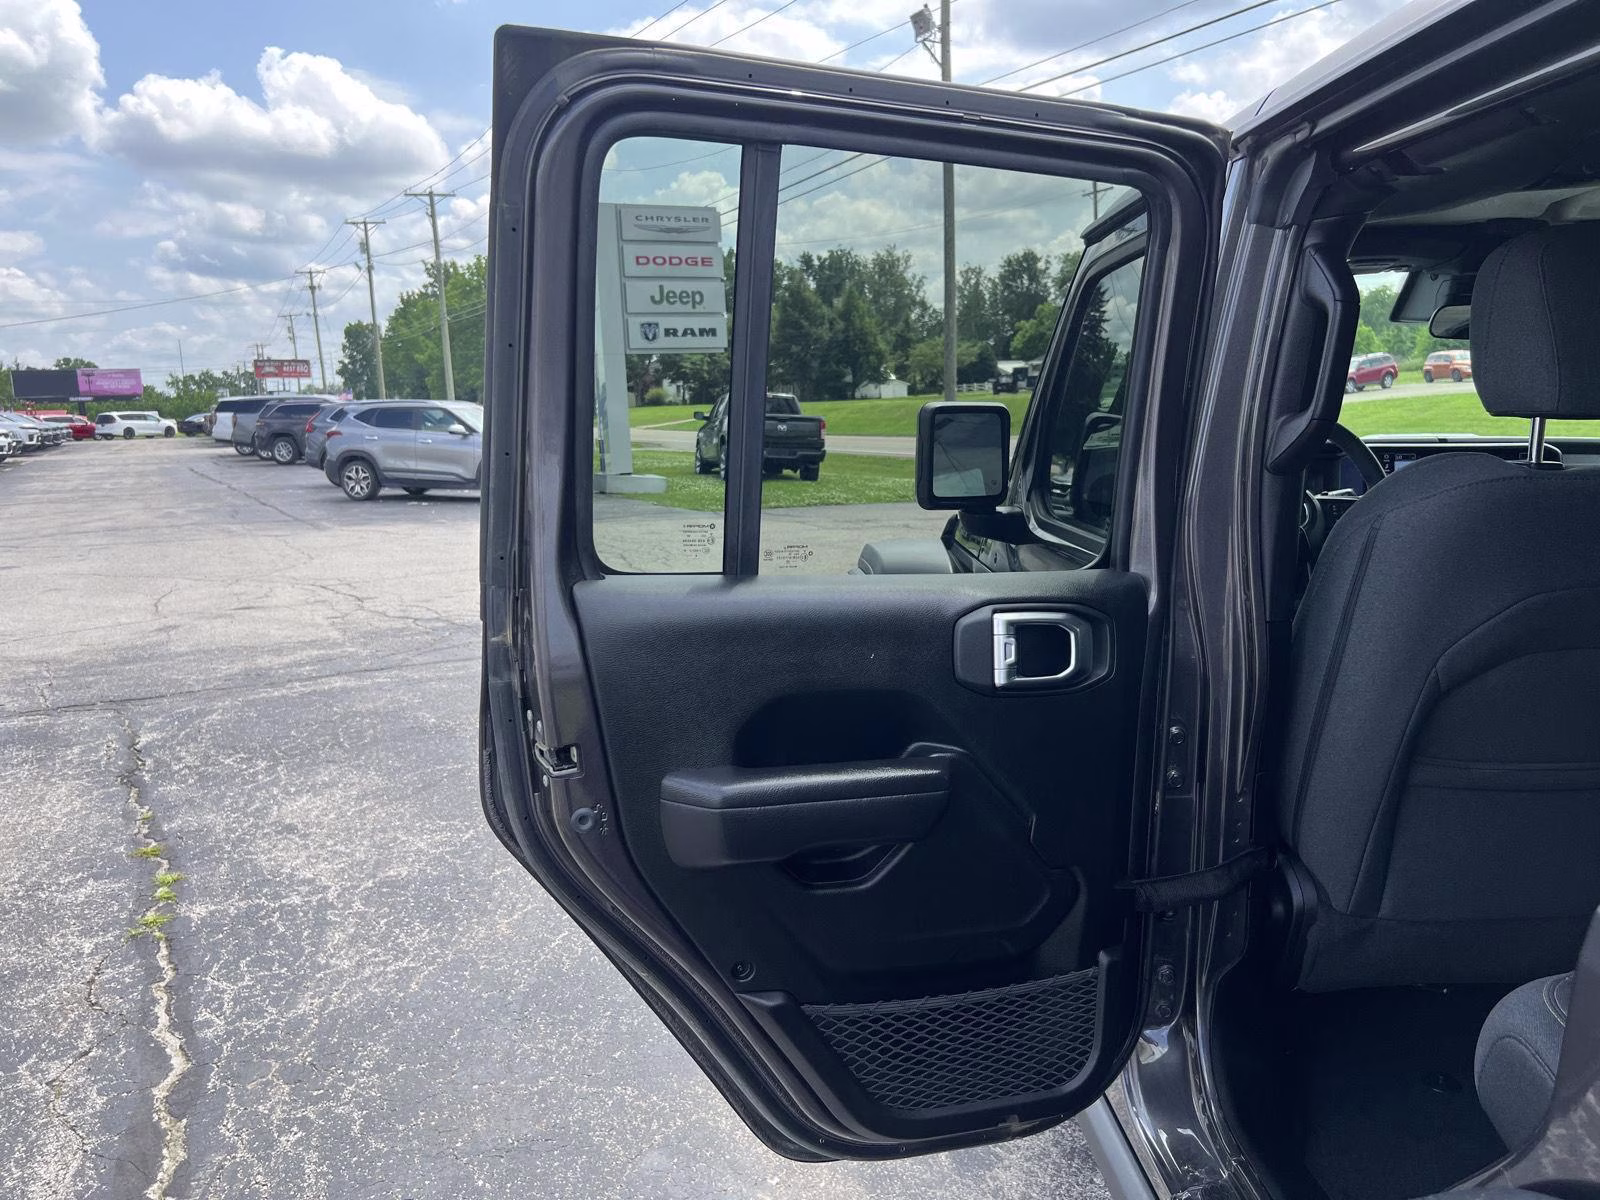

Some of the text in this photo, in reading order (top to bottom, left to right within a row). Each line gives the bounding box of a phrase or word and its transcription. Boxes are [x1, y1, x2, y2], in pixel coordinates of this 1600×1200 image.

[635, 214, 711, 224] CHRYSLER
[635, 255, 714, 267] DODGE
[650, 284, 705, 309] Jeep
[664, 327, 718, 338] RAM
